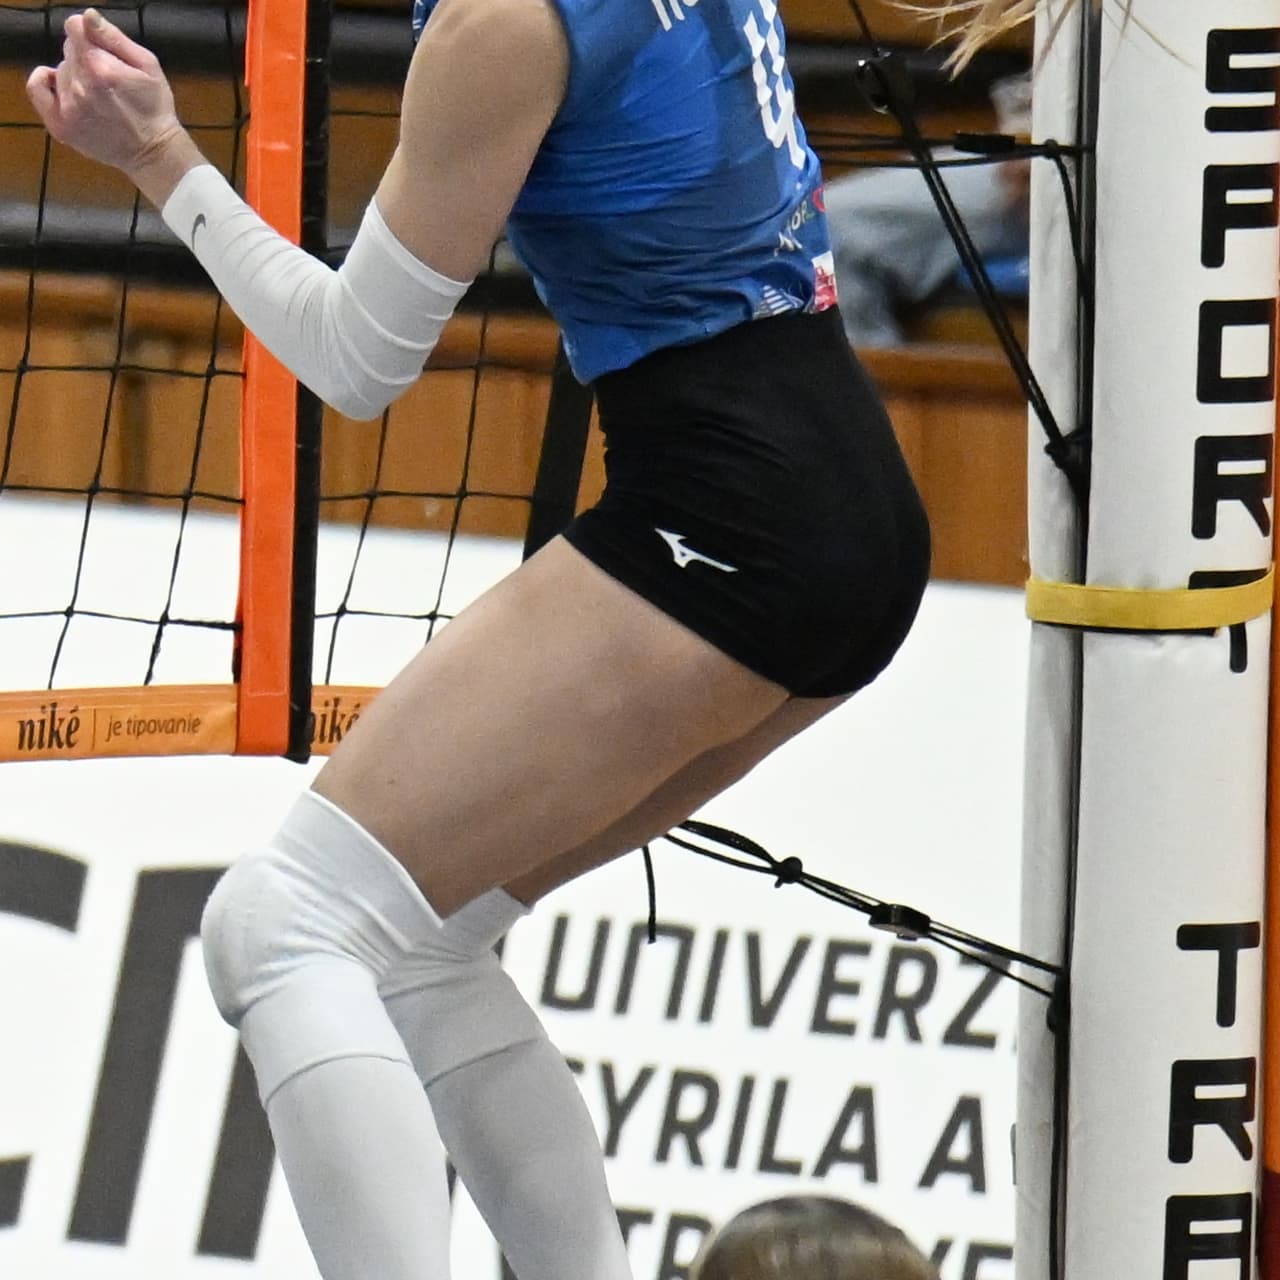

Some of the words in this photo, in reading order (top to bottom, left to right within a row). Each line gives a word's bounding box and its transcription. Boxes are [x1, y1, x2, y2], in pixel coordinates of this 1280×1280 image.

[16, 701, 81, 751] niké
[105, 715, 122, 742] je
[125, 713, 201, 741] tipovanie
[538, 912, 1018, 1051] UNIVERZ
[562, 1054, 880, 1186] YRILA
